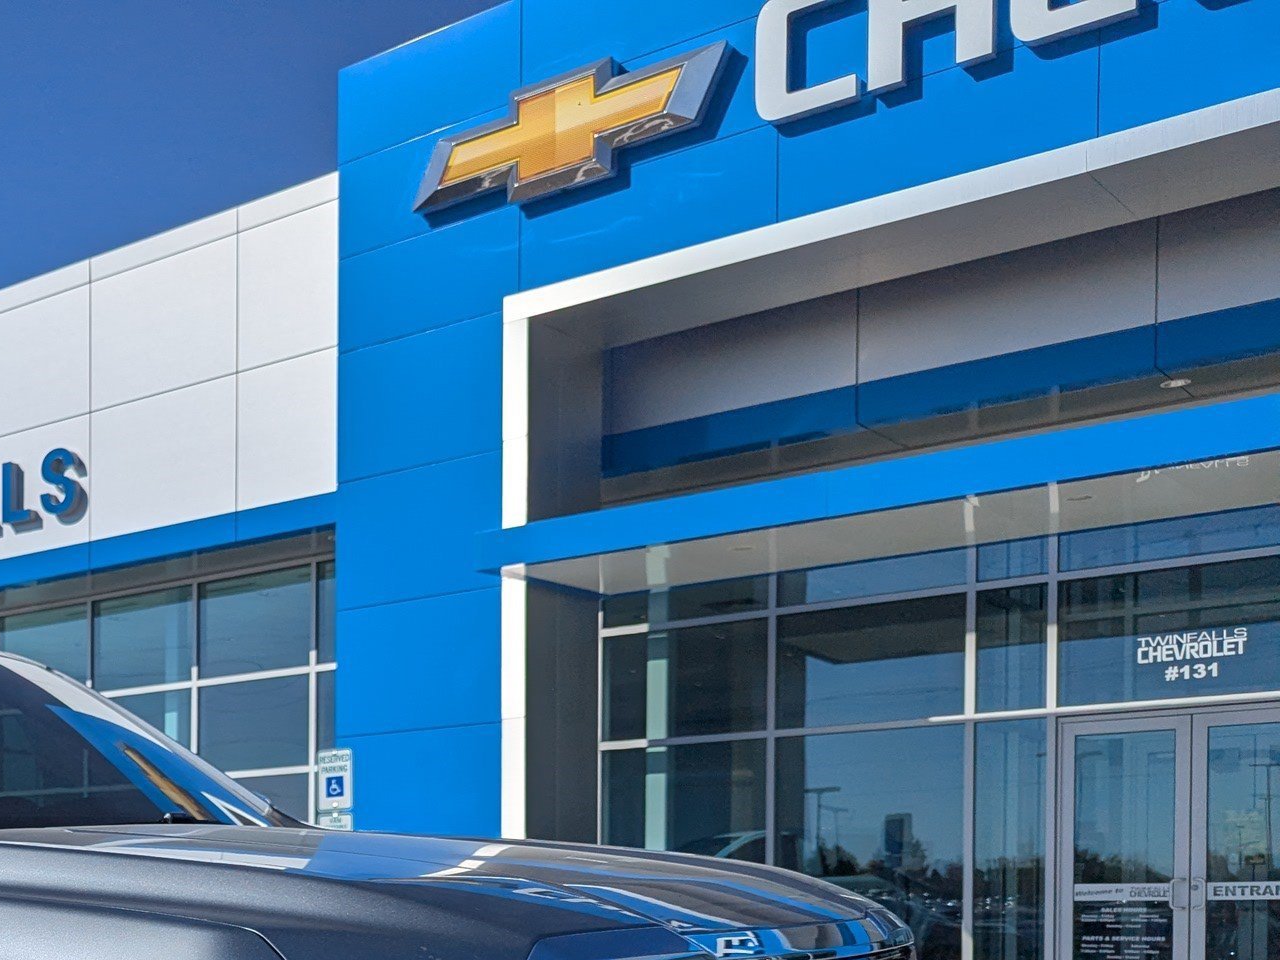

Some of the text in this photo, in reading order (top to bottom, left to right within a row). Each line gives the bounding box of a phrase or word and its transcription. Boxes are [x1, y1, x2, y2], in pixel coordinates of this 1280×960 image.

[1137, 637, 1248, 664] CHEVROLET
[1164, 662, 1219, 682] #131
[319, 754, 350, 764] RESERVED
[321, 764, 348, 774] PARKING
